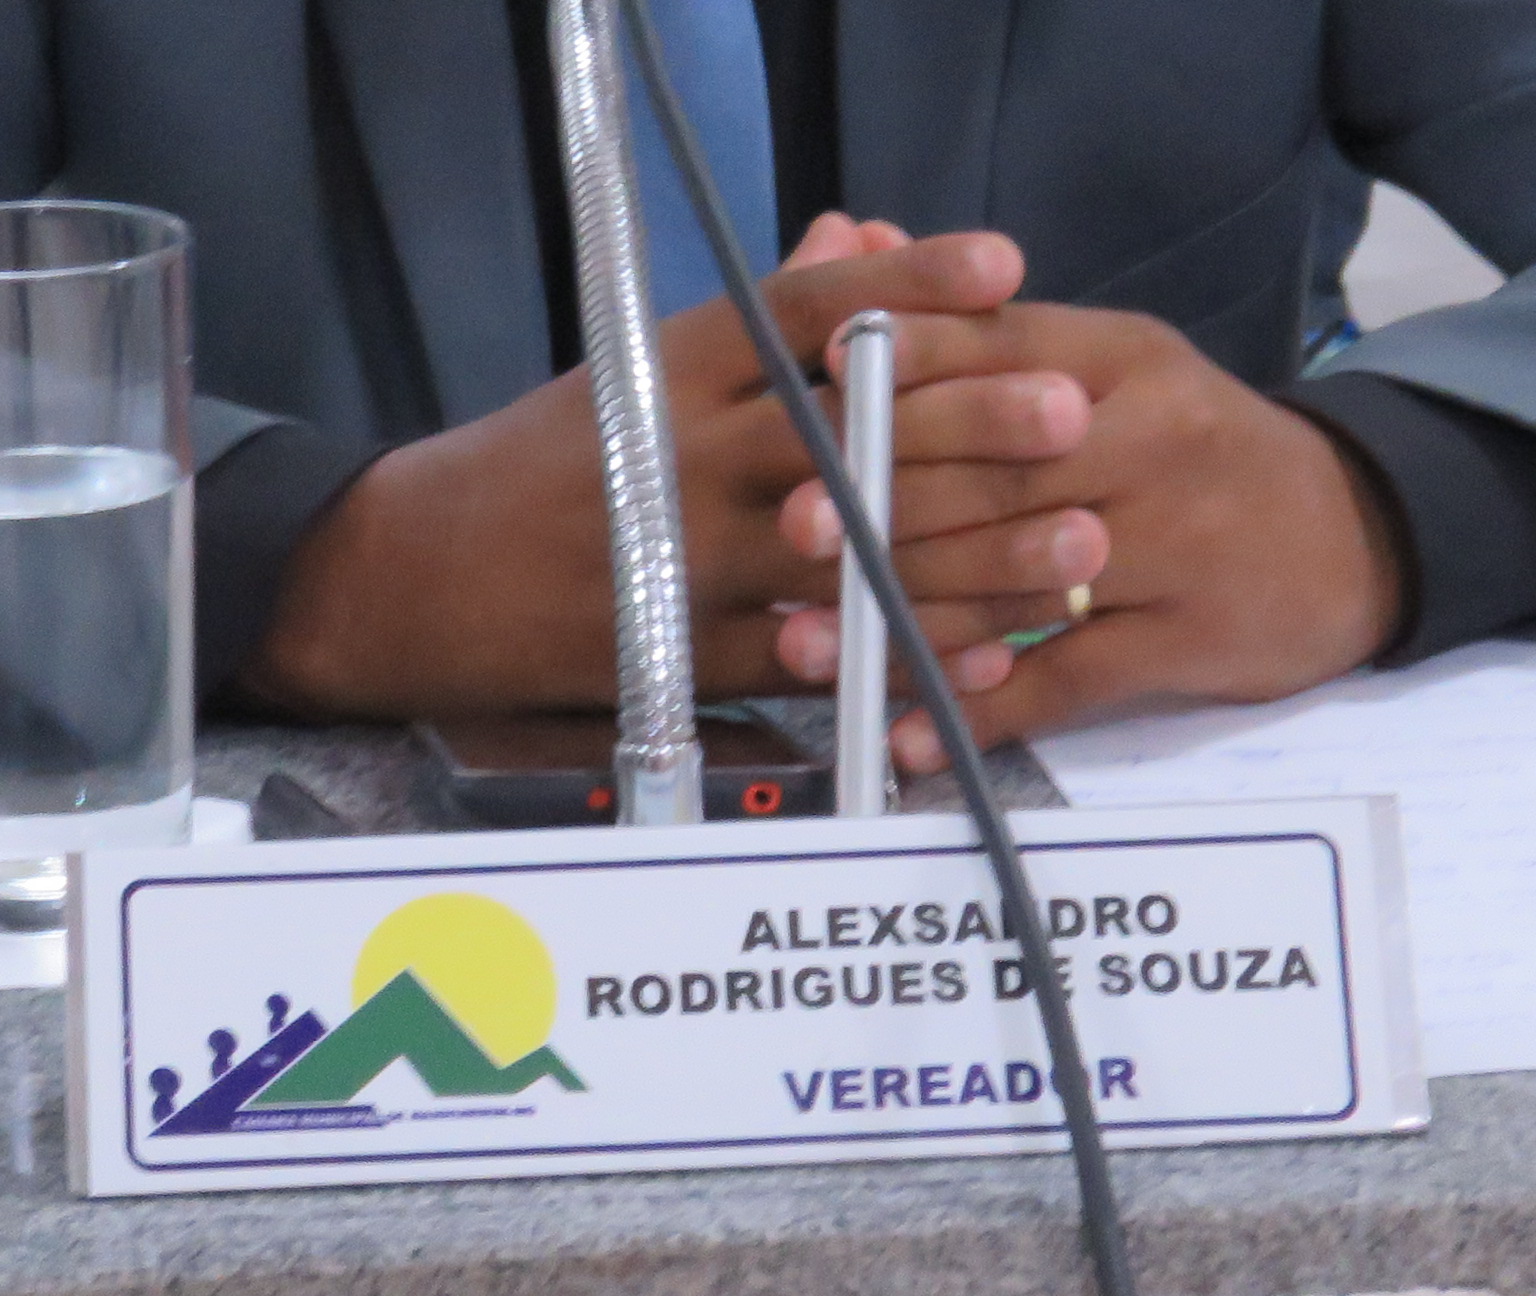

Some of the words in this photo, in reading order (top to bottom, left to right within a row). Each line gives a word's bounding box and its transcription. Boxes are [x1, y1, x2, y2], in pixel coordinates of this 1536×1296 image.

[740, 892, 1181, 953] ALEXSADRO
[585, 959, 968, 1019] RODRIGUES
[1098, 946, 1319, 996] SOUZA
[782, 1056, 1139, 1115] VEREADR
